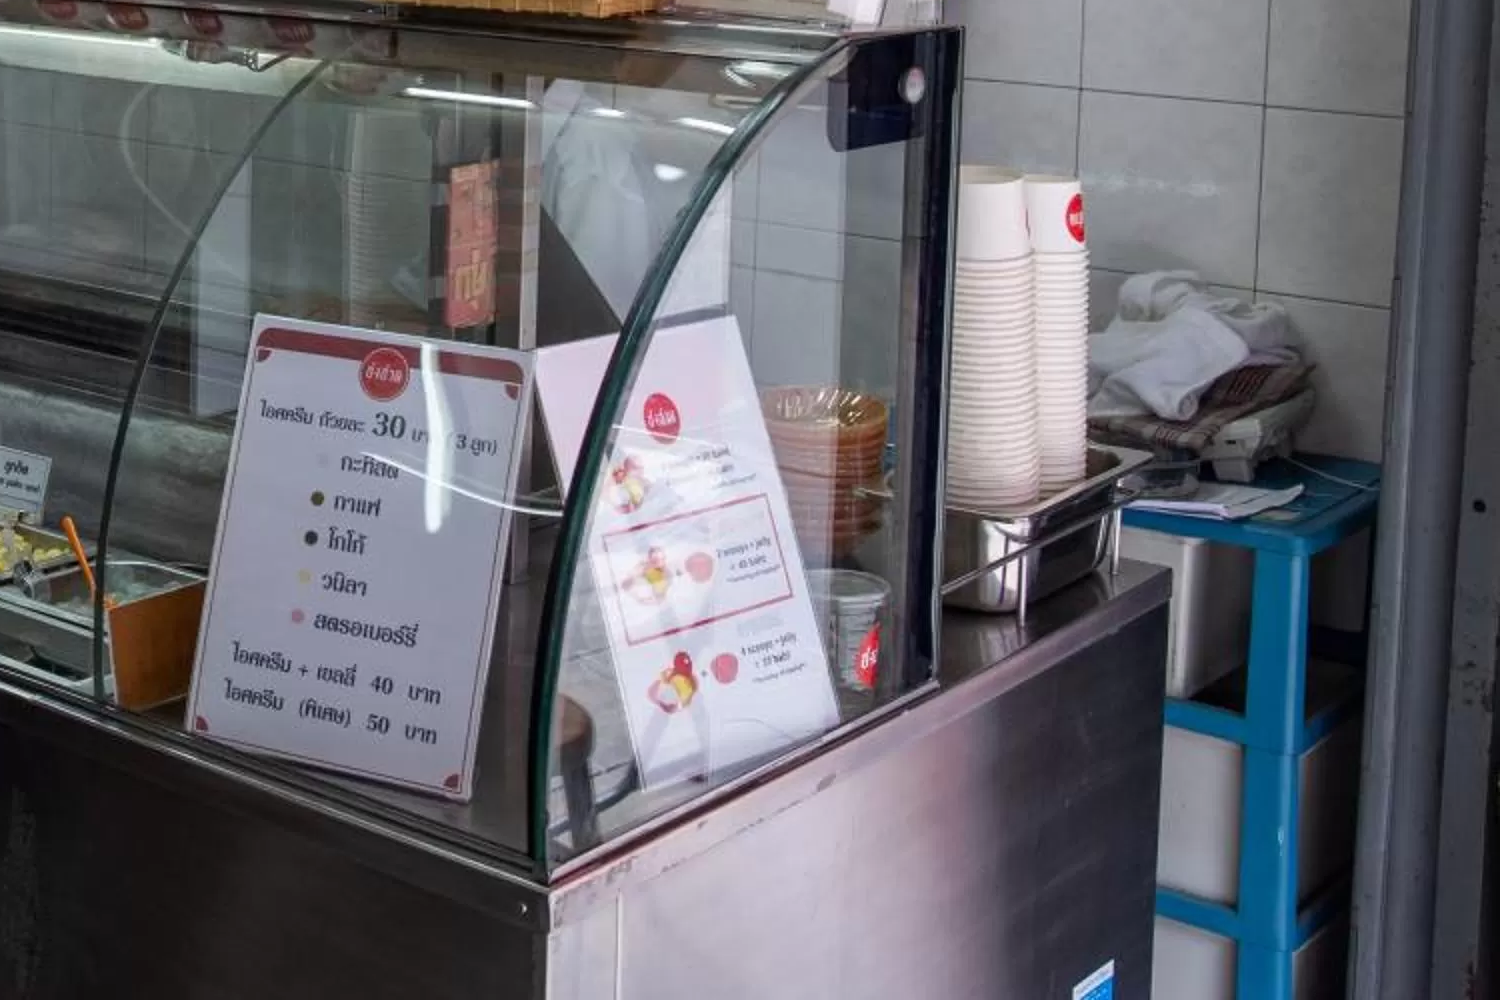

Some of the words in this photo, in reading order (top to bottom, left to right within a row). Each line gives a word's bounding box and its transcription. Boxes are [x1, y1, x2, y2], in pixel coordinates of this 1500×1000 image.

[372, 411, 407, 439] 30
[333, 494, 383, 517] กาแฟ
[327, 525, 368, 556] โกโก้
[370, 675, 394, 696] 40
[408, 684, 442, 705] บาท
[365, 713, 391, 735] 50
[404, 722, 438, 745] บาท
